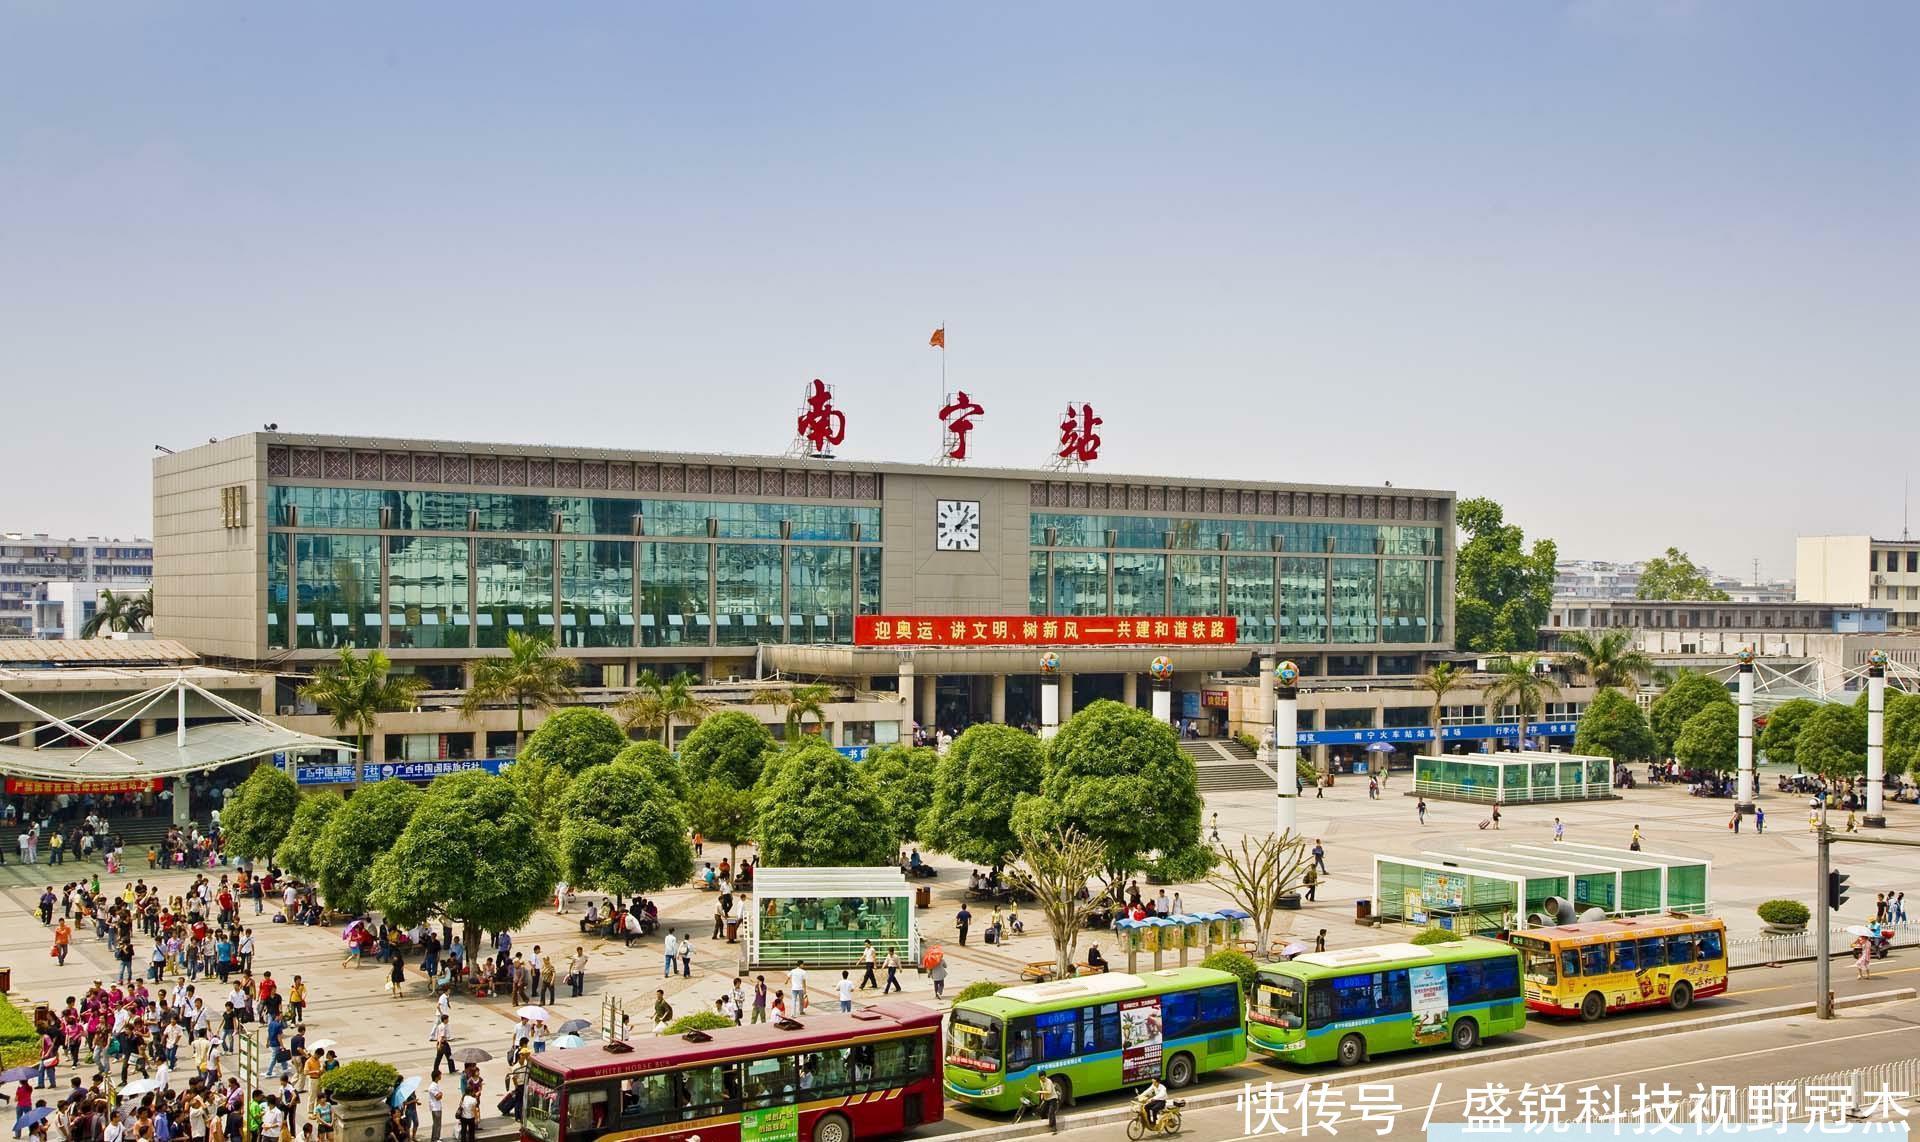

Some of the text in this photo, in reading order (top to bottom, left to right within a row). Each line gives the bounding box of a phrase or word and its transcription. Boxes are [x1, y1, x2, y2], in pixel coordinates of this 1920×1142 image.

[797, 379, 1103, 462] 南宁站
[395, 761, 480, 774] 广西中国国际旅行社
[594, 1066, 620, 1076] WHITE
[625, 1063, 652, 1072] HORSE
